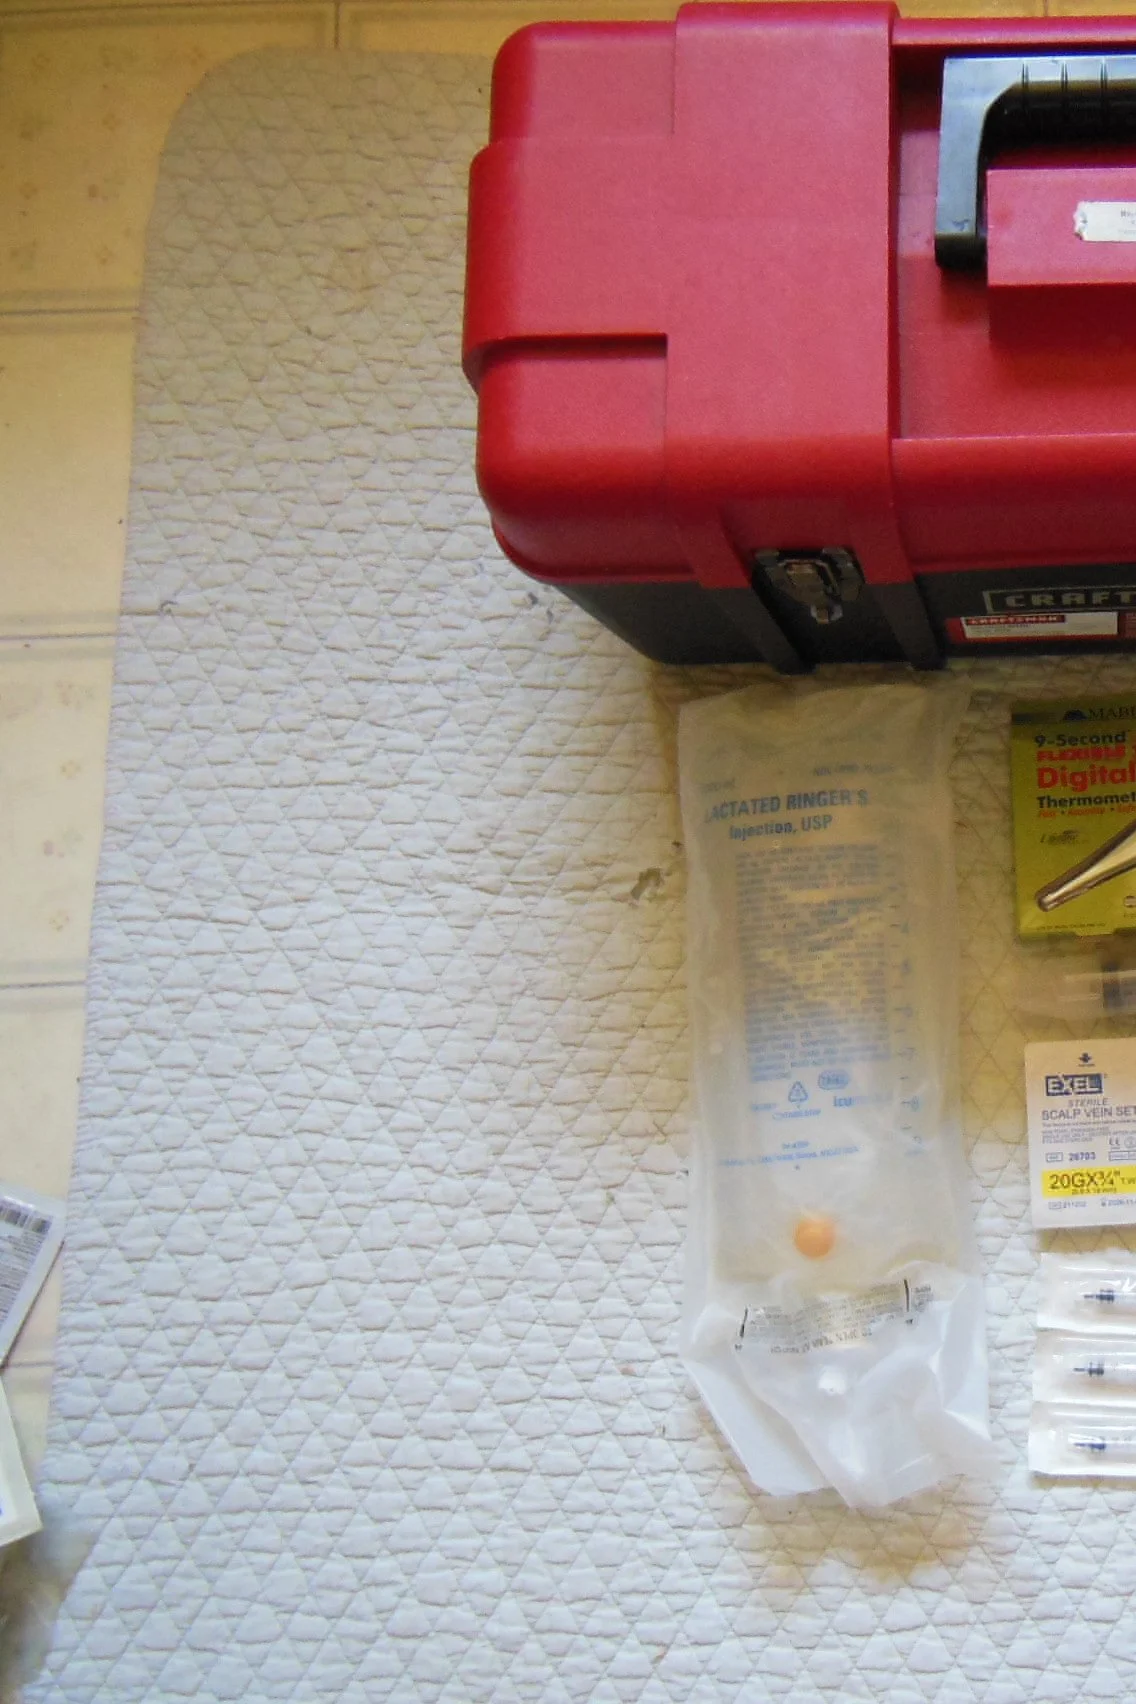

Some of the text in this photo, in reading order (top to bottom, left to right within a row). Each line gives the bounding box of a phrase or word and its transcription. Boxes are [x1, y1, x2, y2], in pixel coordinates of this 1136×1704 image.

[1035, 731, 1127, 748] 9-Second
[1037, 760, 1136, 793] Digital
[786, 787, 869, 810] RINGERS
[801, 814, 834, 831] USP
[1046, 1074, 1101, 1095] EXEL
[1041, 1108, 1081, 1120] SCALP
[1083, 1106, 1113, 1118] VEIN
